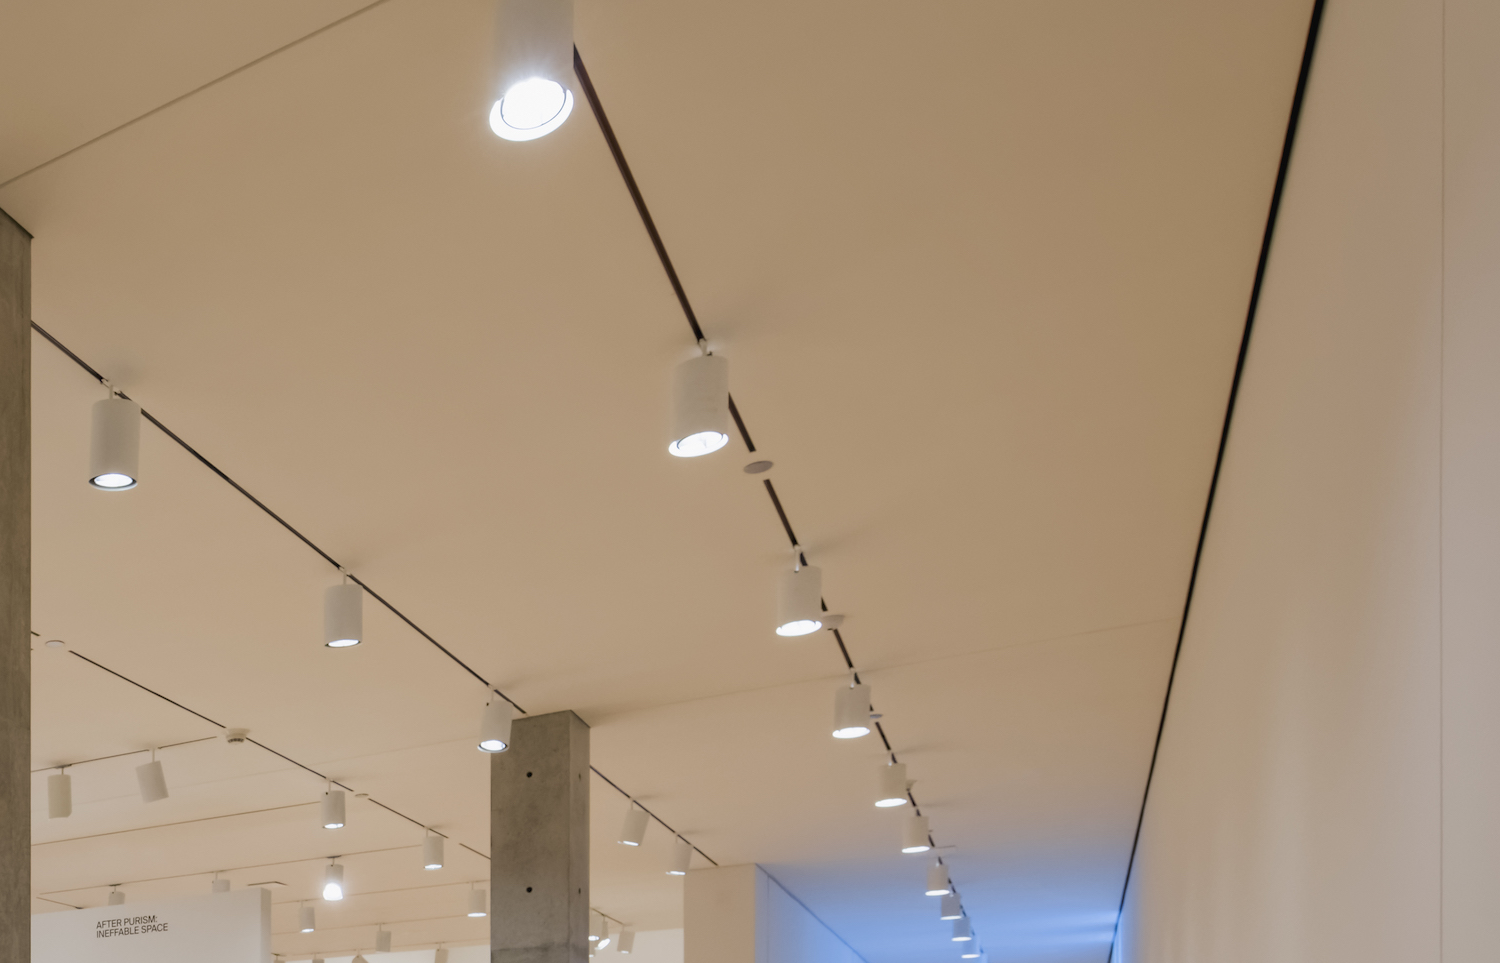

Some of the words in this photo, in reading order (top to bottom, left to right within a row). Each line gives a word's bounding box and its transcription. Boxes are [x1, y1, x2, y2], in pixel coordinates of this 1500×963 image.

[96, 918, 123, 929] AFTER
[123, 915, 158, 926] PURISM:
[96, 926, 140, 938] INEFFABLE
[140, 922, 169, 934] SPACE
